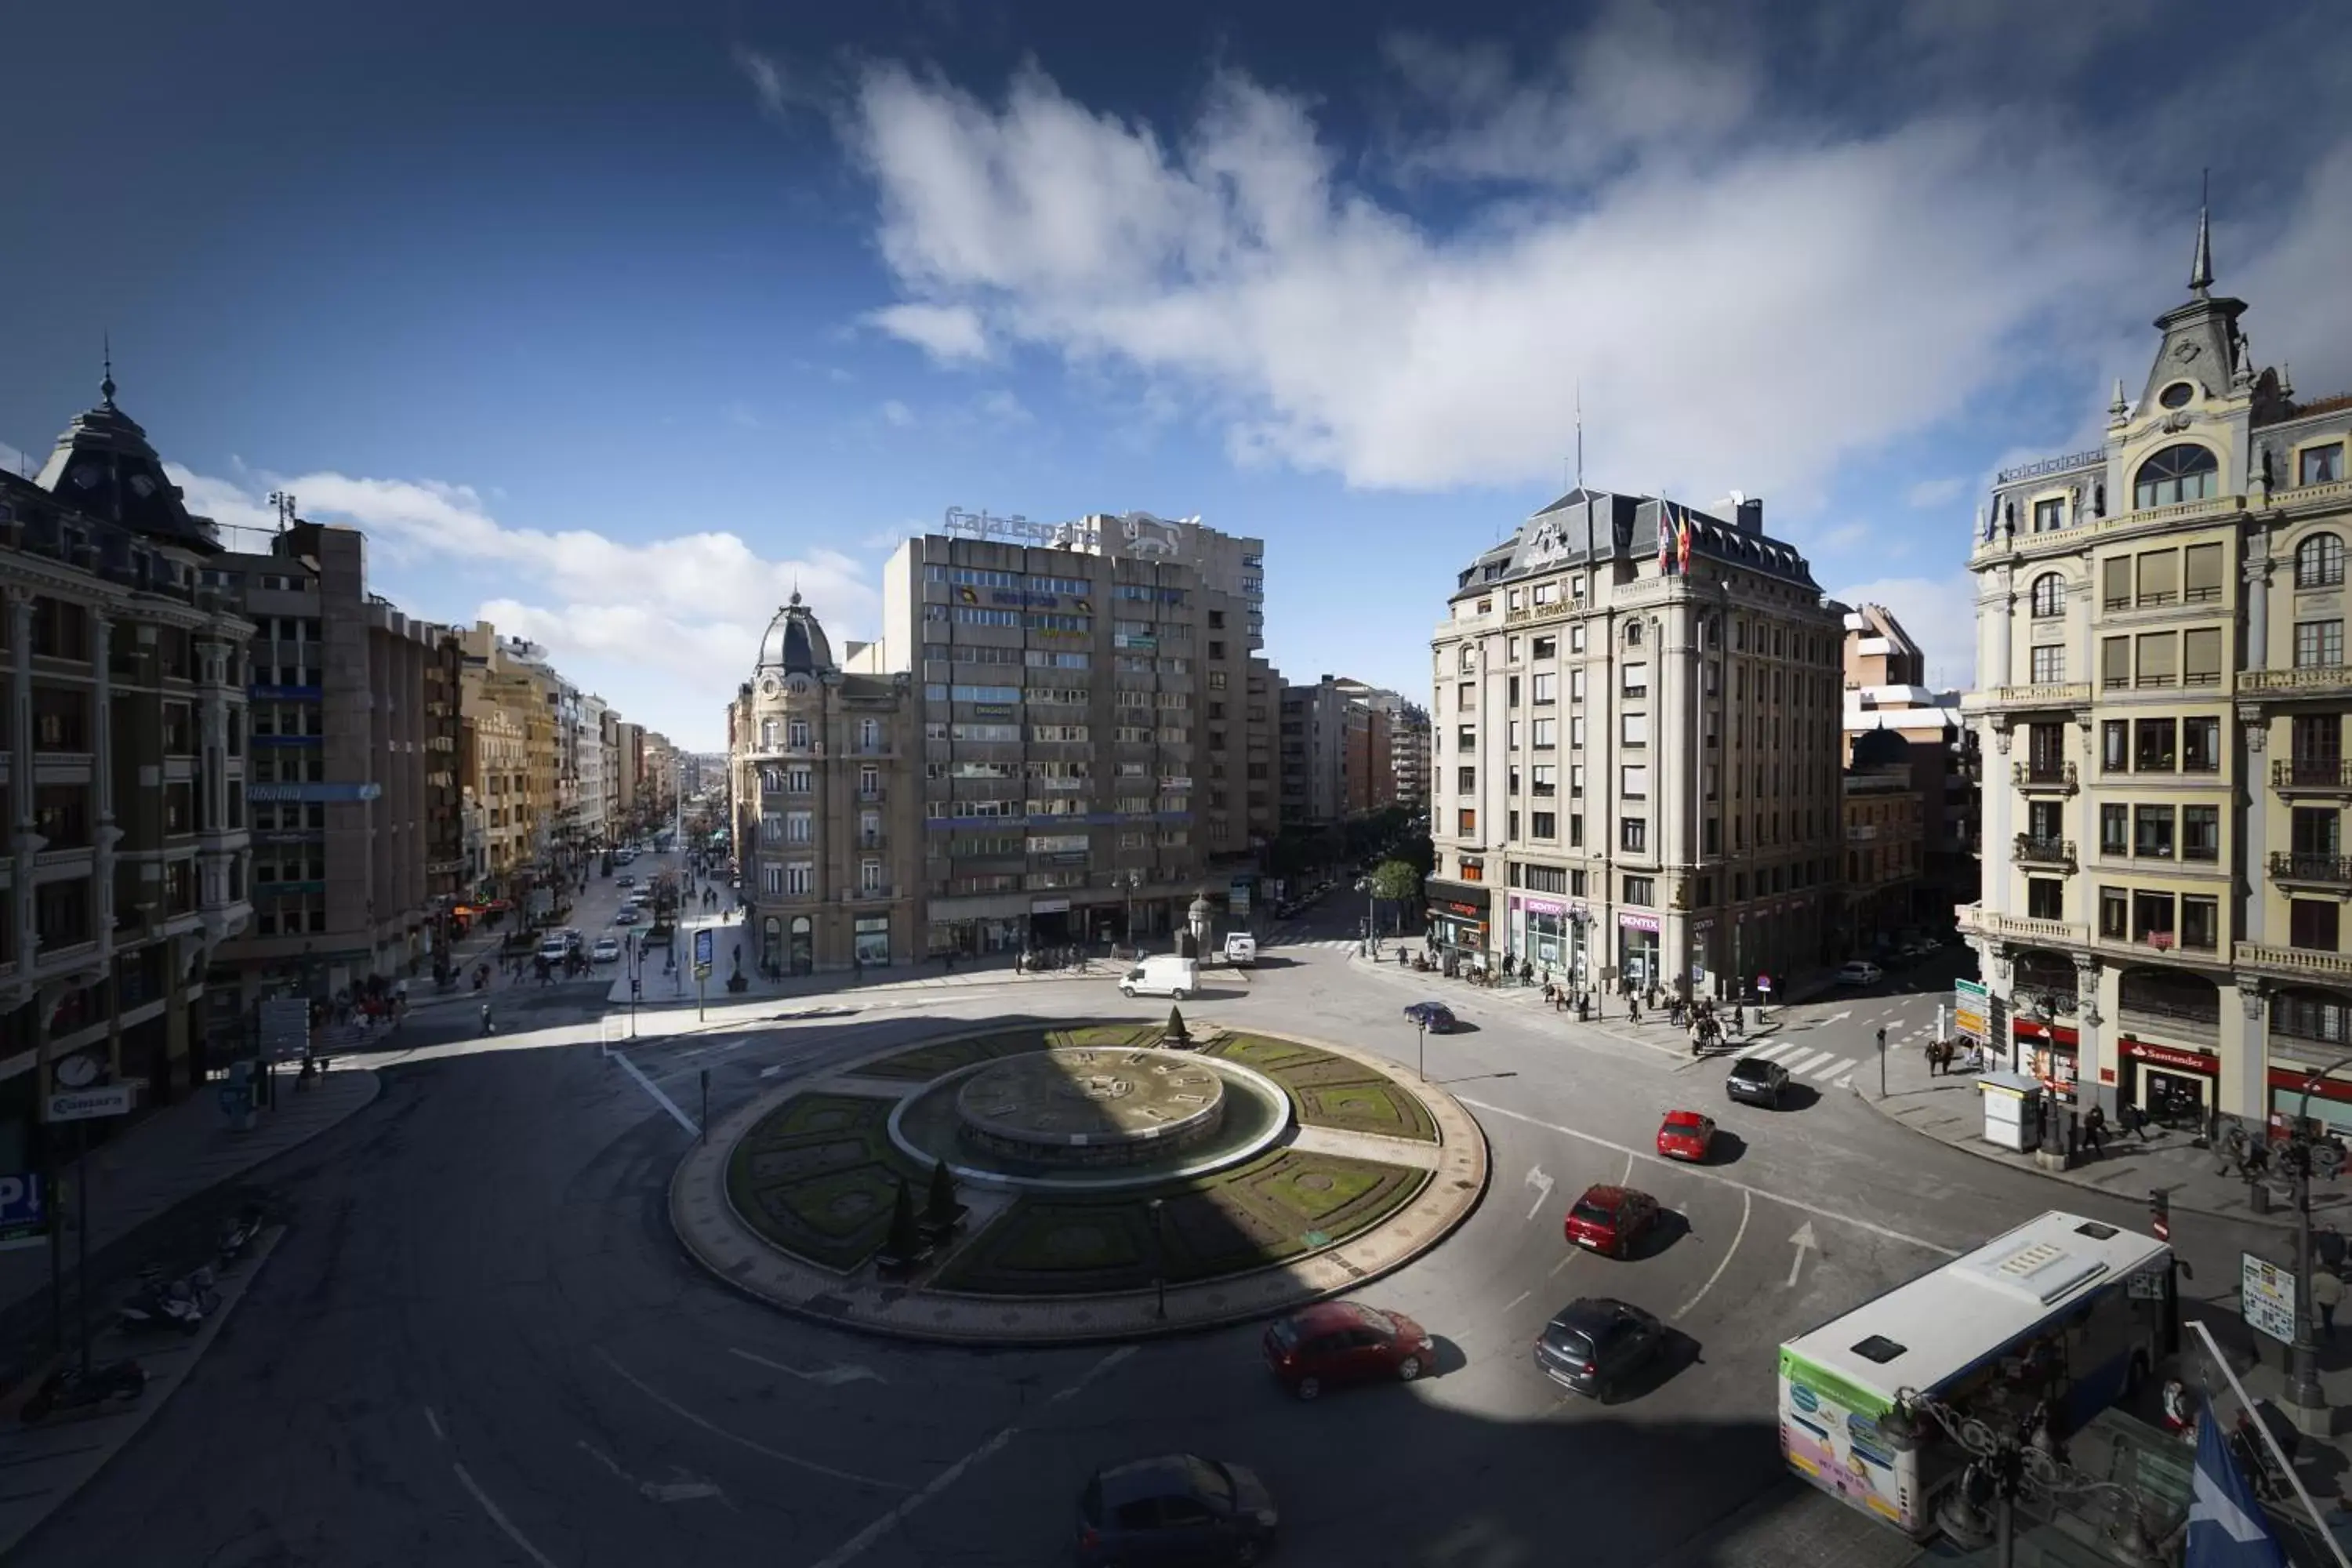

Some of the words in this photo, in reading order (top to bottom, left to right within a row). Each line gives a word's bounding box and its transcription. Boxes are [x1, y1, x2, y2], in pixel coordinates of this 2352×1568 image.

[945, 506, 1005, 540] Caja
[1011, 514, 1100, 546] España
[1619, 914, 1658, 929] DENTIX
[2147, 1049, 2204, 1067] Santander
